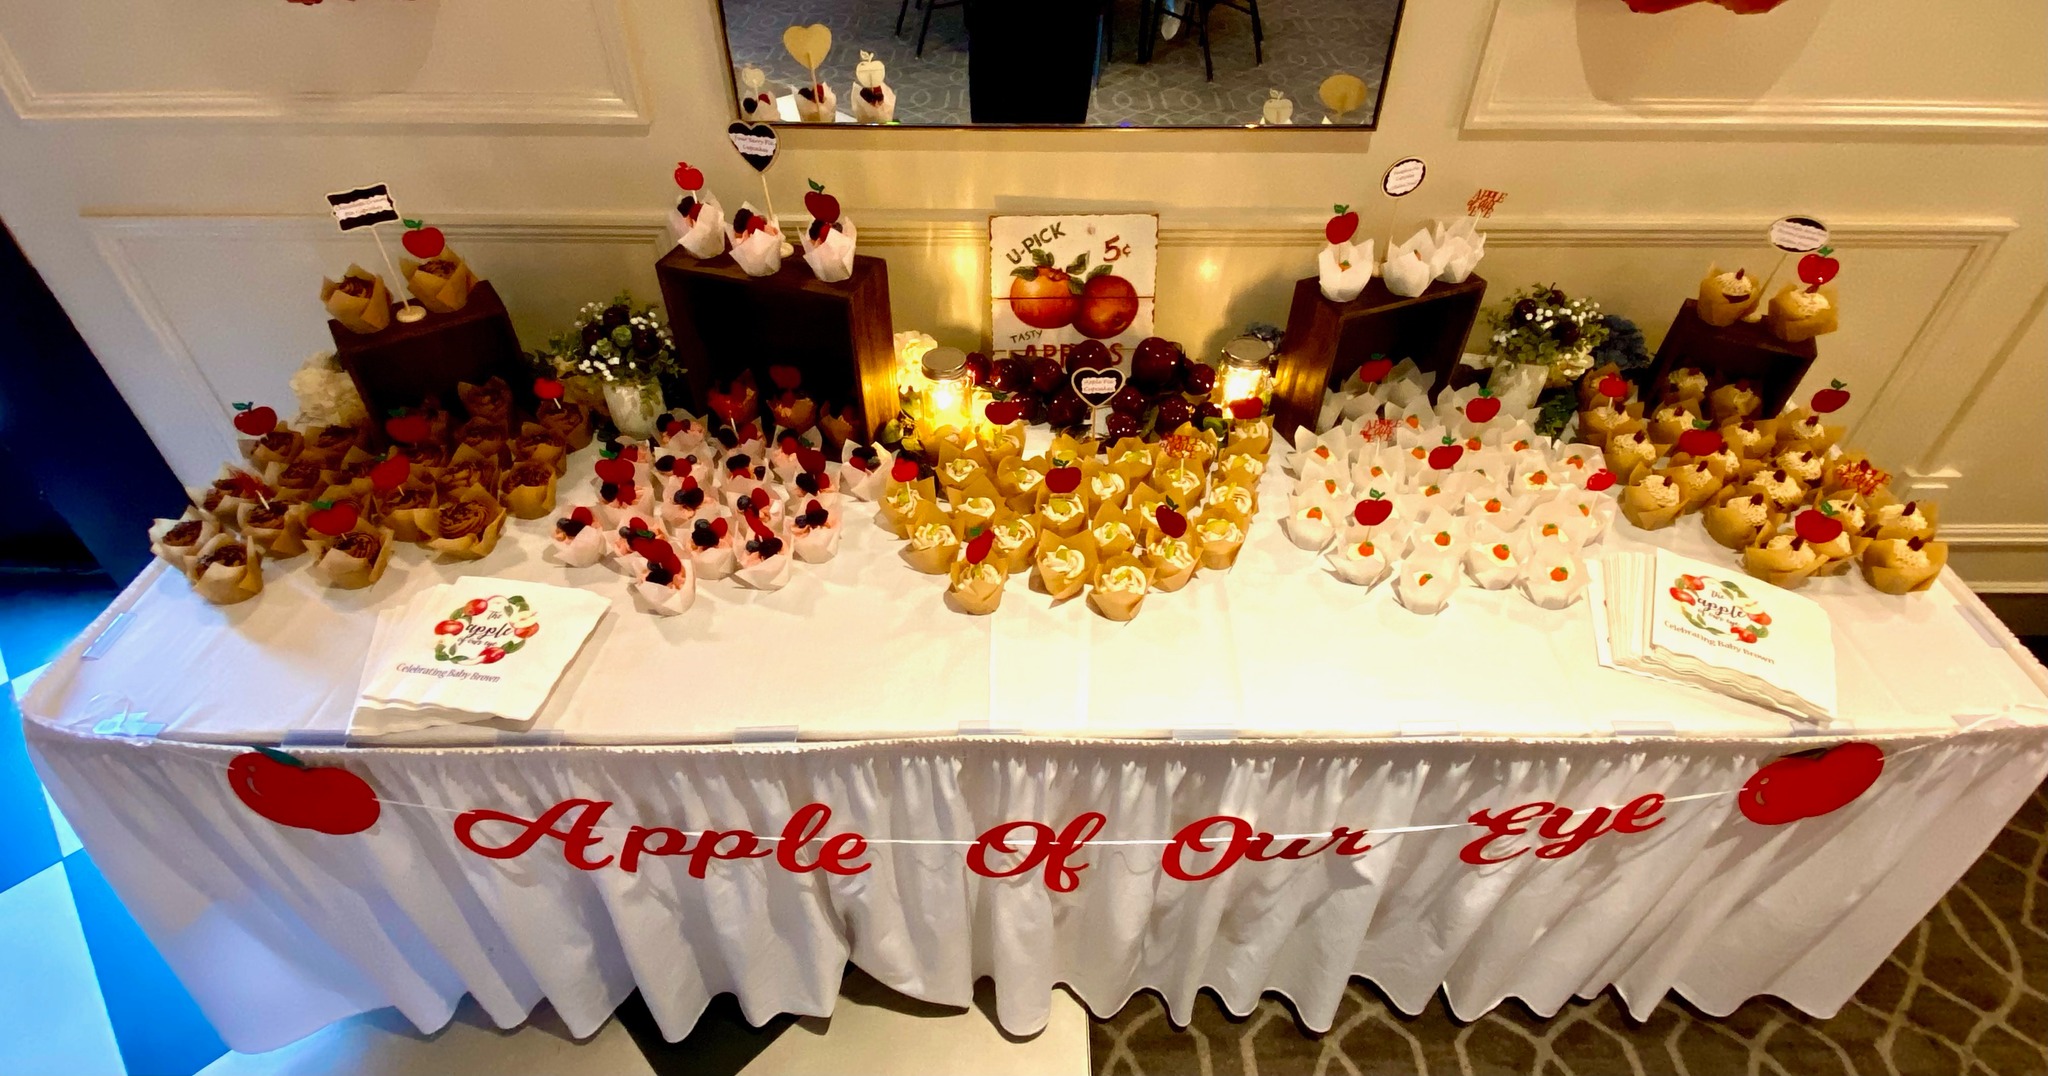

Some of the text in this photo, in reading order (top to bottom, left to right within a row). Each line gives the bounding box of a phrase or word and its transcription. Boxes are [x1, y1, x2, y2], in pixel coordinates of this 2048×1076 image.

[1005, 221, 1066, 265] U-PICK
[1010, 329, 1043, 344] TASTY
[1025, 342, 1123, 368] APPS
[487, 610, 502, 620] The
[1697, 597, 1746, 618] apple
[465, 622, 513, 640] apple
[1664, 620, 1775, 665] Celebrating Baby Brown
[396, 662, 501, 684] Celebrating Baby Brown
[454, 792, 1666, 894] Apple Of Our Eye
